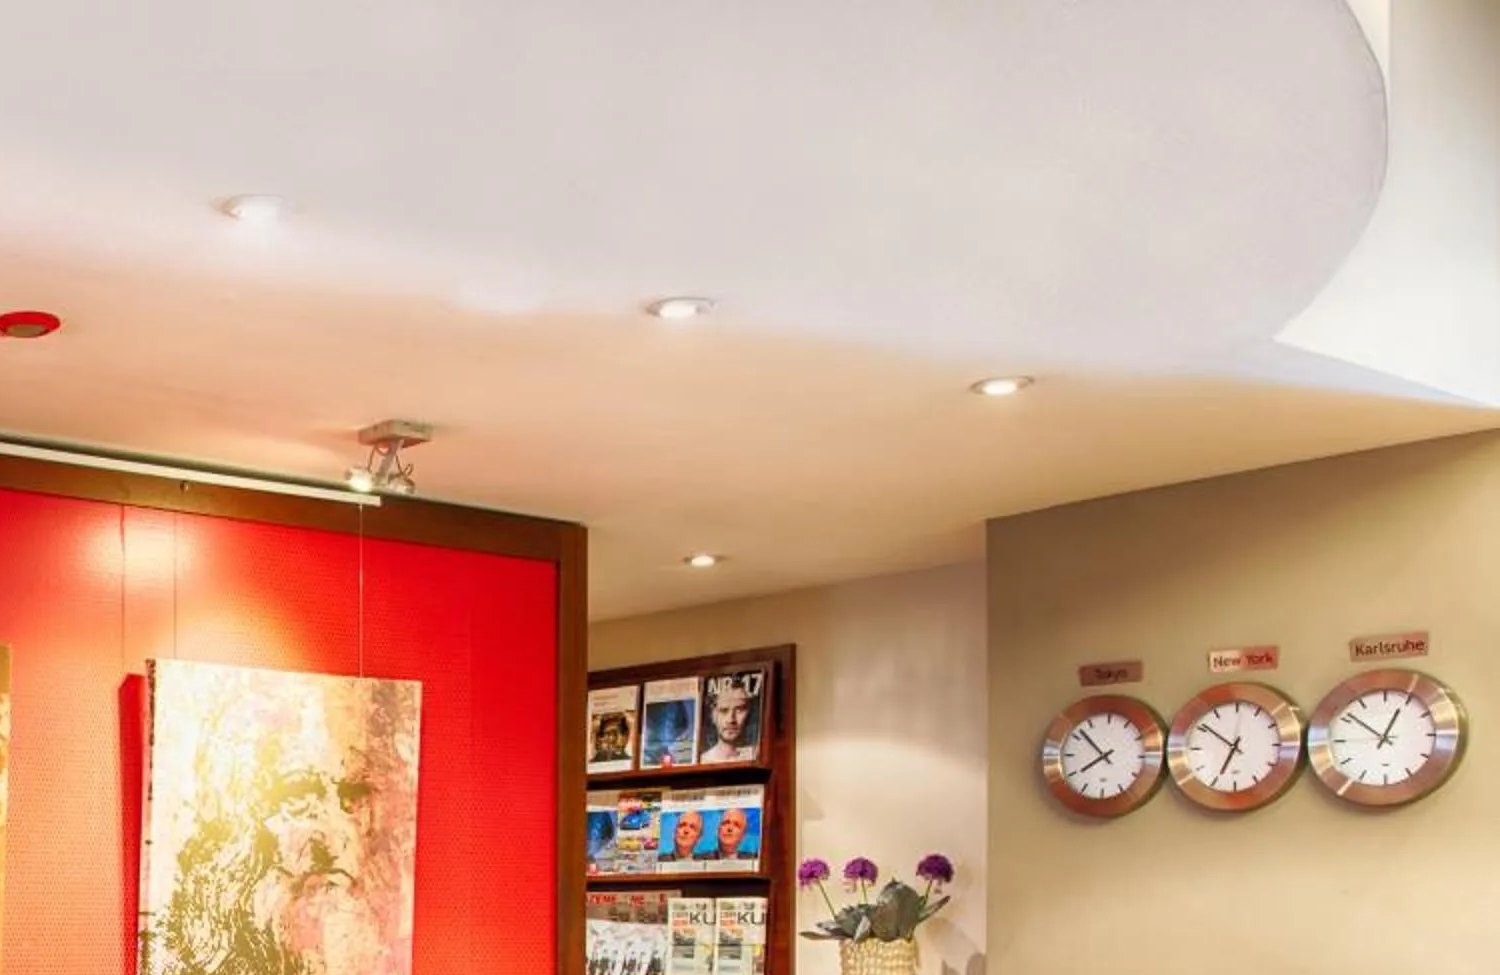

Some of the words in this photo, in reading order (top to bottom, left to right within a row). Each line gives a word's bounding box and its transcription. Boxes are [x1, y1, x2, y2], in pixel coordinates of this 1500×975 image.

[1355, 639, 1426, 656] Karlsruhe
[1213, 654, 1242, 668] New
[1245, 651, 1273, 665] York
